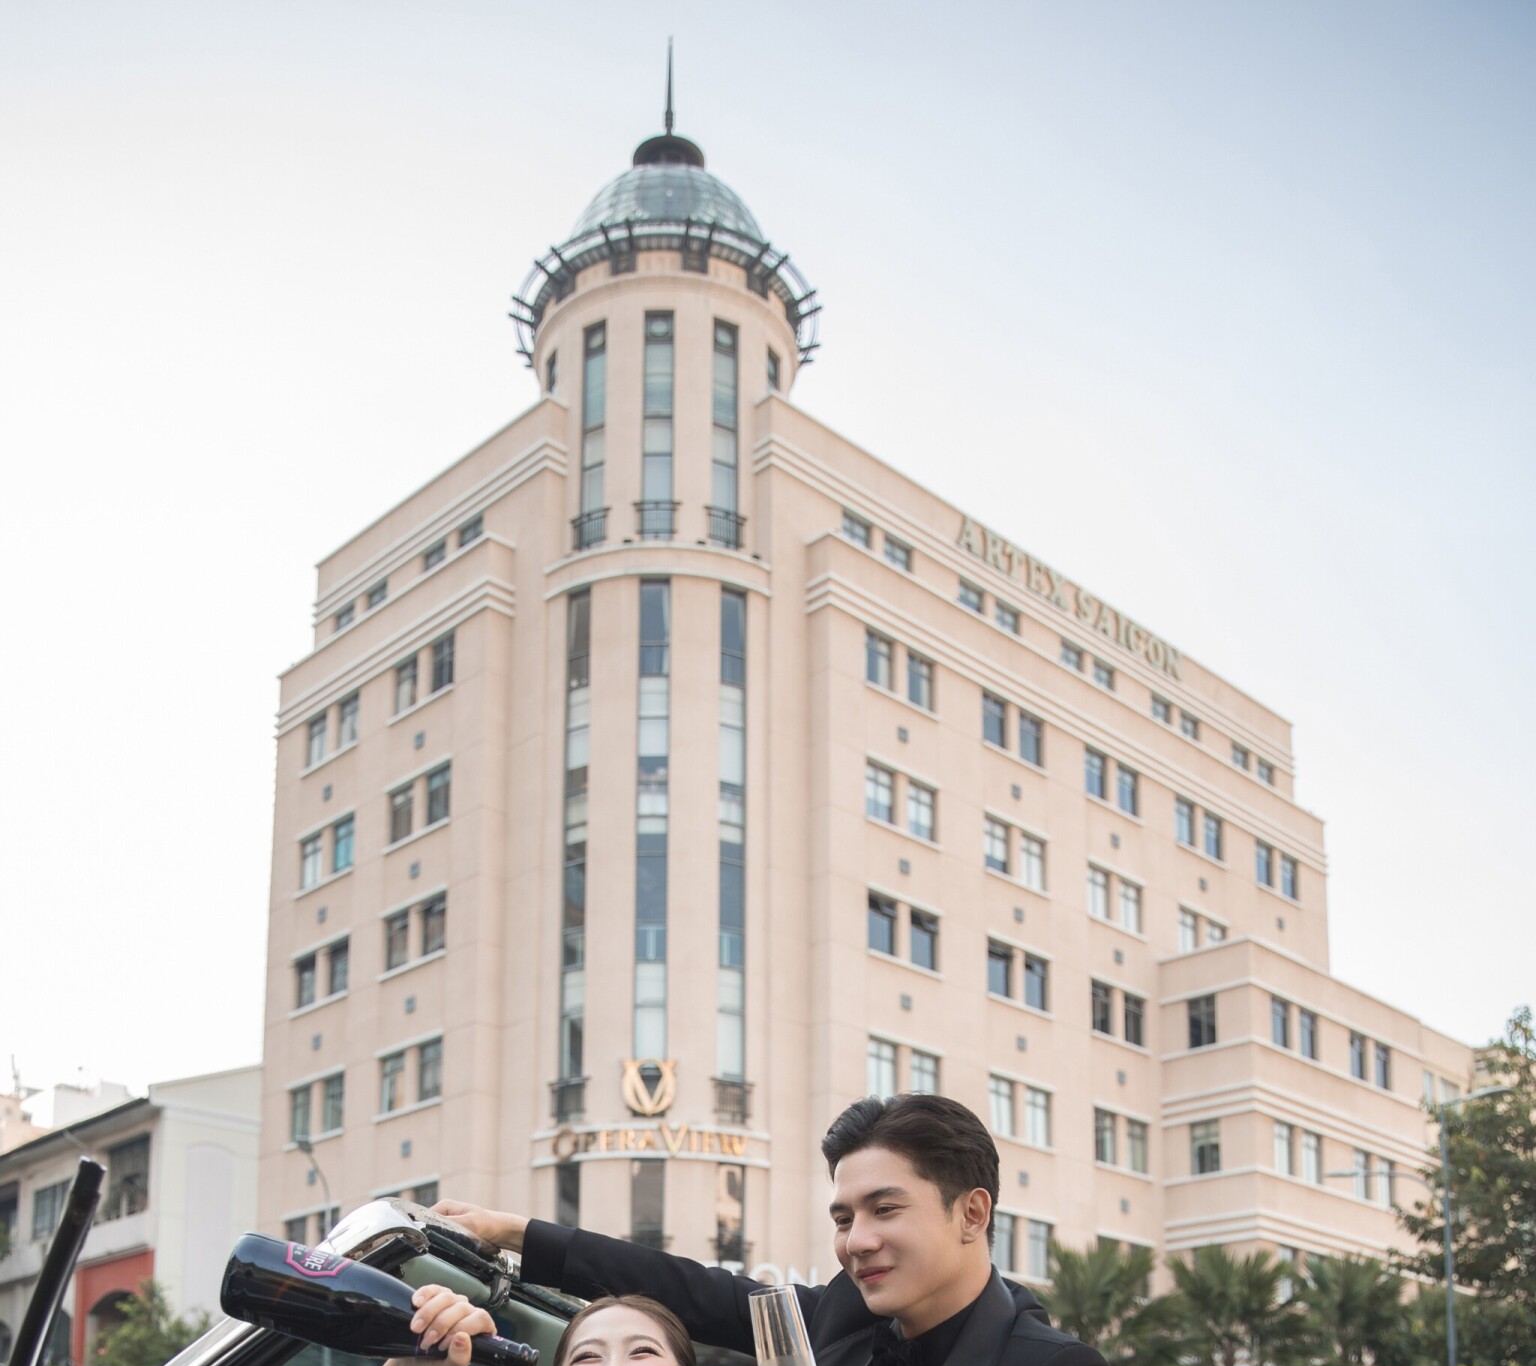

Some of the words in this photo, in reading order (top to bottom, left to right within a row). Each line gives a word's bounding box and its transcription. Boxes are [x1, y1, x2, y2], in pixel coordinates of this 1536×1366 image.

[957, 514, 1068, 612] ARTEX
[1075, 586, 1181, 682] SAIGON
[553, 1127, 655, 1161] OPERA
[660, 1123, 748, 1157] VIEW
